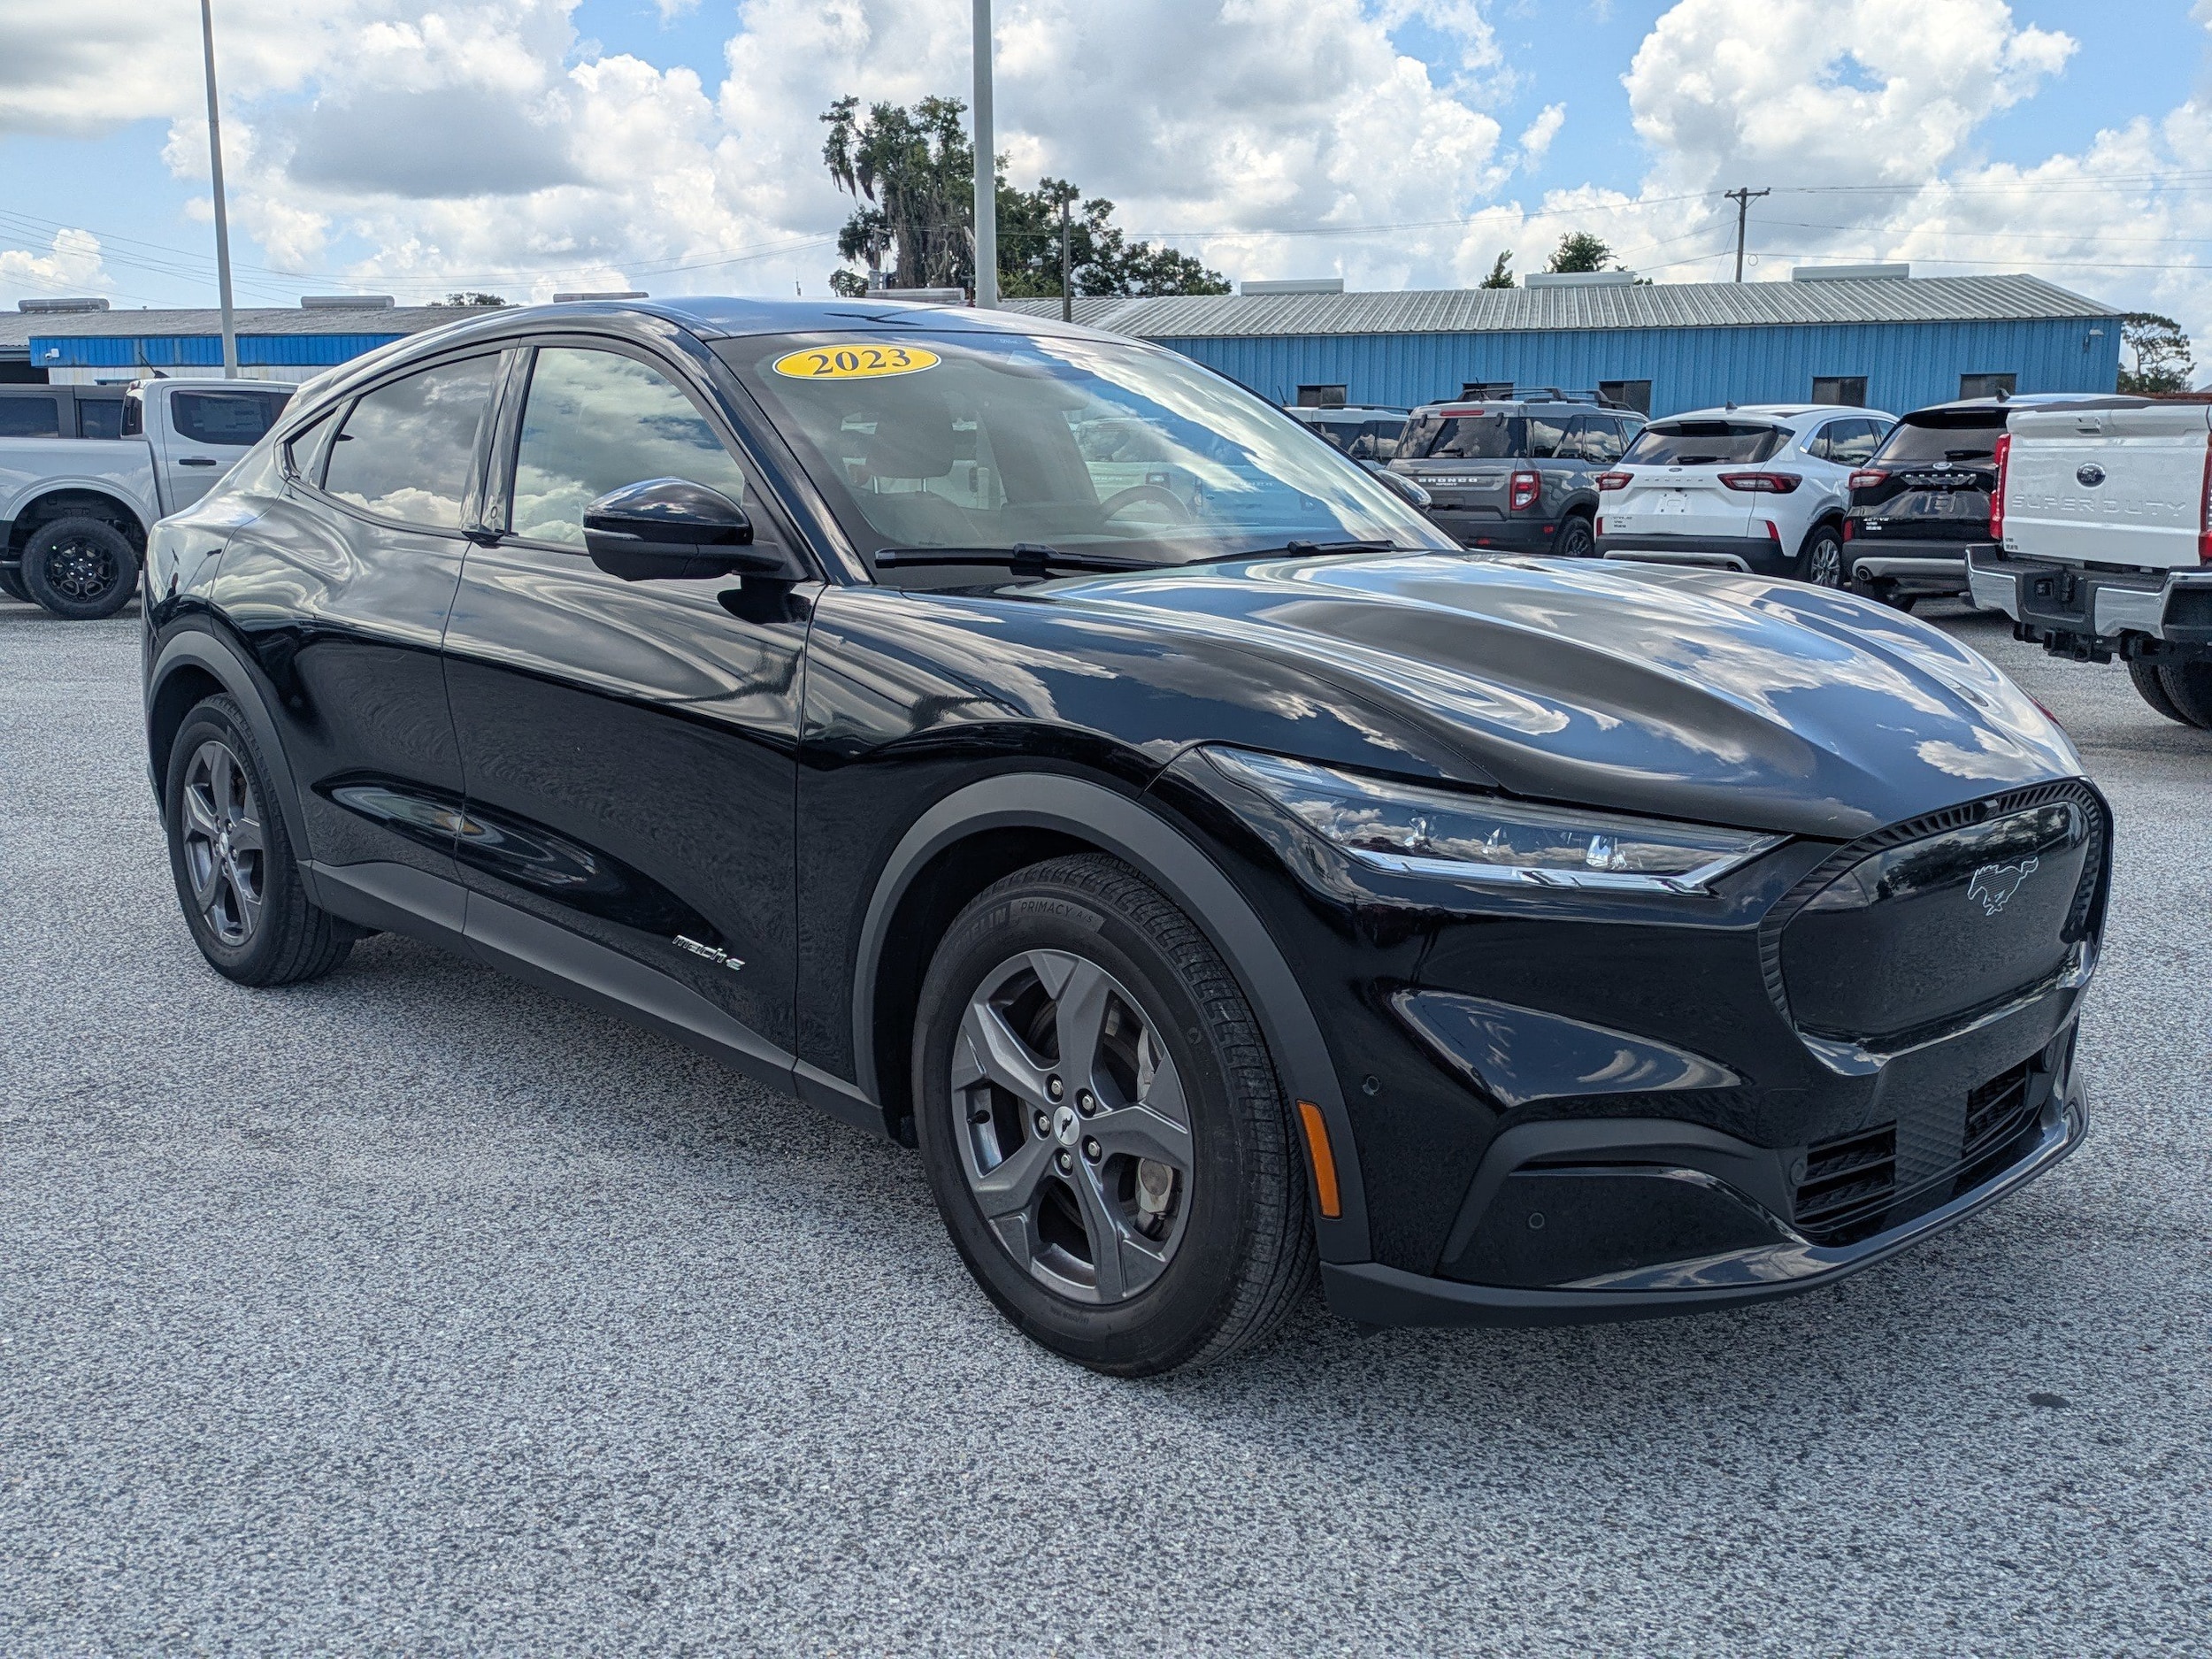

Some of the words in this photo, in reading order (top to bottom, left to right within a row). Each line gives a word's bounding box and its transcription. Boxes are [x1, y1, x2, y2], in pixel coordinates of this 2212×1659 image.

[808, 349, 911, 375] 2023
[2011, 494, 2095, 512] SUPER
[2102, 498, 2186, 517] DUTY
[1020, 901, 1074, 918] PRIMACY
[1076, 910, 1094, 923] A/S
